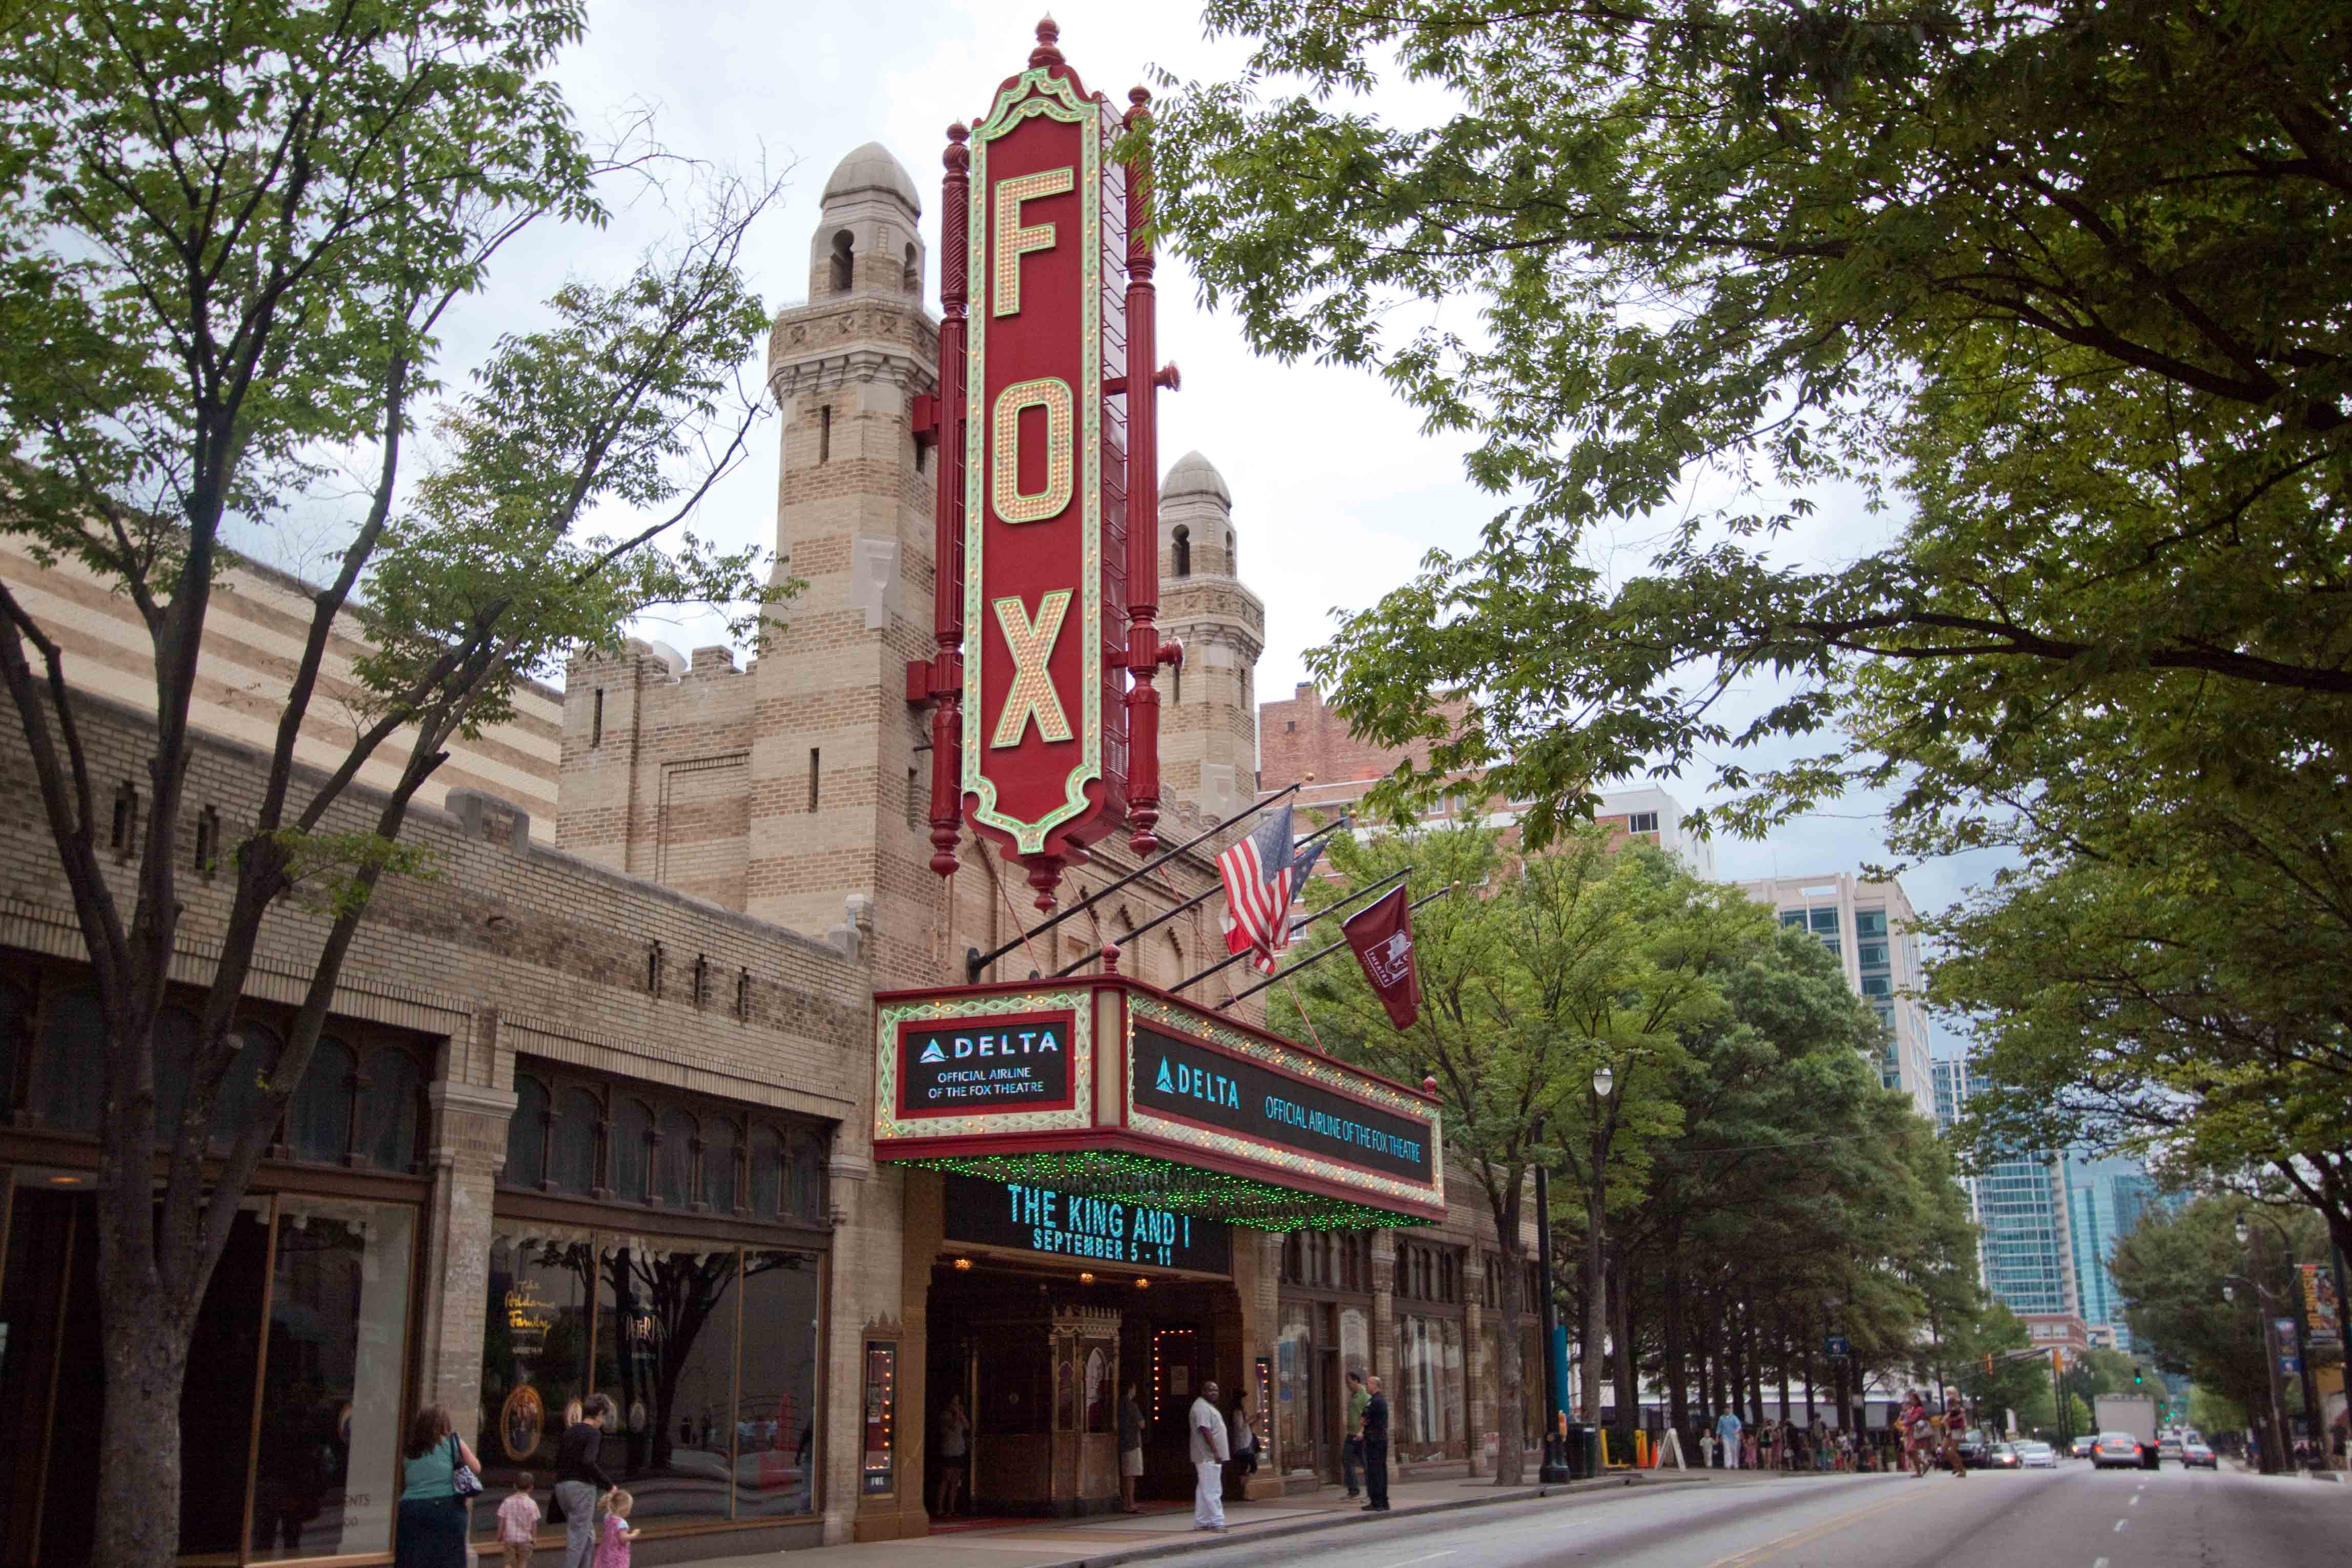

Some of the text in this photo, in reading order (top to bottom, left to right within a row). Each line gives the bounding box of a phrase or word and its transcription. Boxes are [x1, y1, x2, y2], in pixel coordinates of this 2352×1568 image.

[990, 166, 1074, 748] FOX
[1368, 951, 1389, 982] THEATRE
[954, 1031, 1058, 1058] DELTA
[928, 1081, 1044, 1099] OF THE FOX THEATRE
[938, 1067, 1032, 1083] OFFICIAL AIRLINE
[1178, 1062, 1240, 1110] DELTA
[1265, 1096, 1421, 1163] OFFICIAL AIRLINE OF THE FOX THEATRE
[1008, 1184, 1190, 1248] THE KING AND I
[1032, 1228, 1123, 1261] SEPTEMBER
[1130, 1242, 1138, 1262] 5
[1157, 1245, 1172, 1266] 11
[508, 1309, 553, 1337] Family
